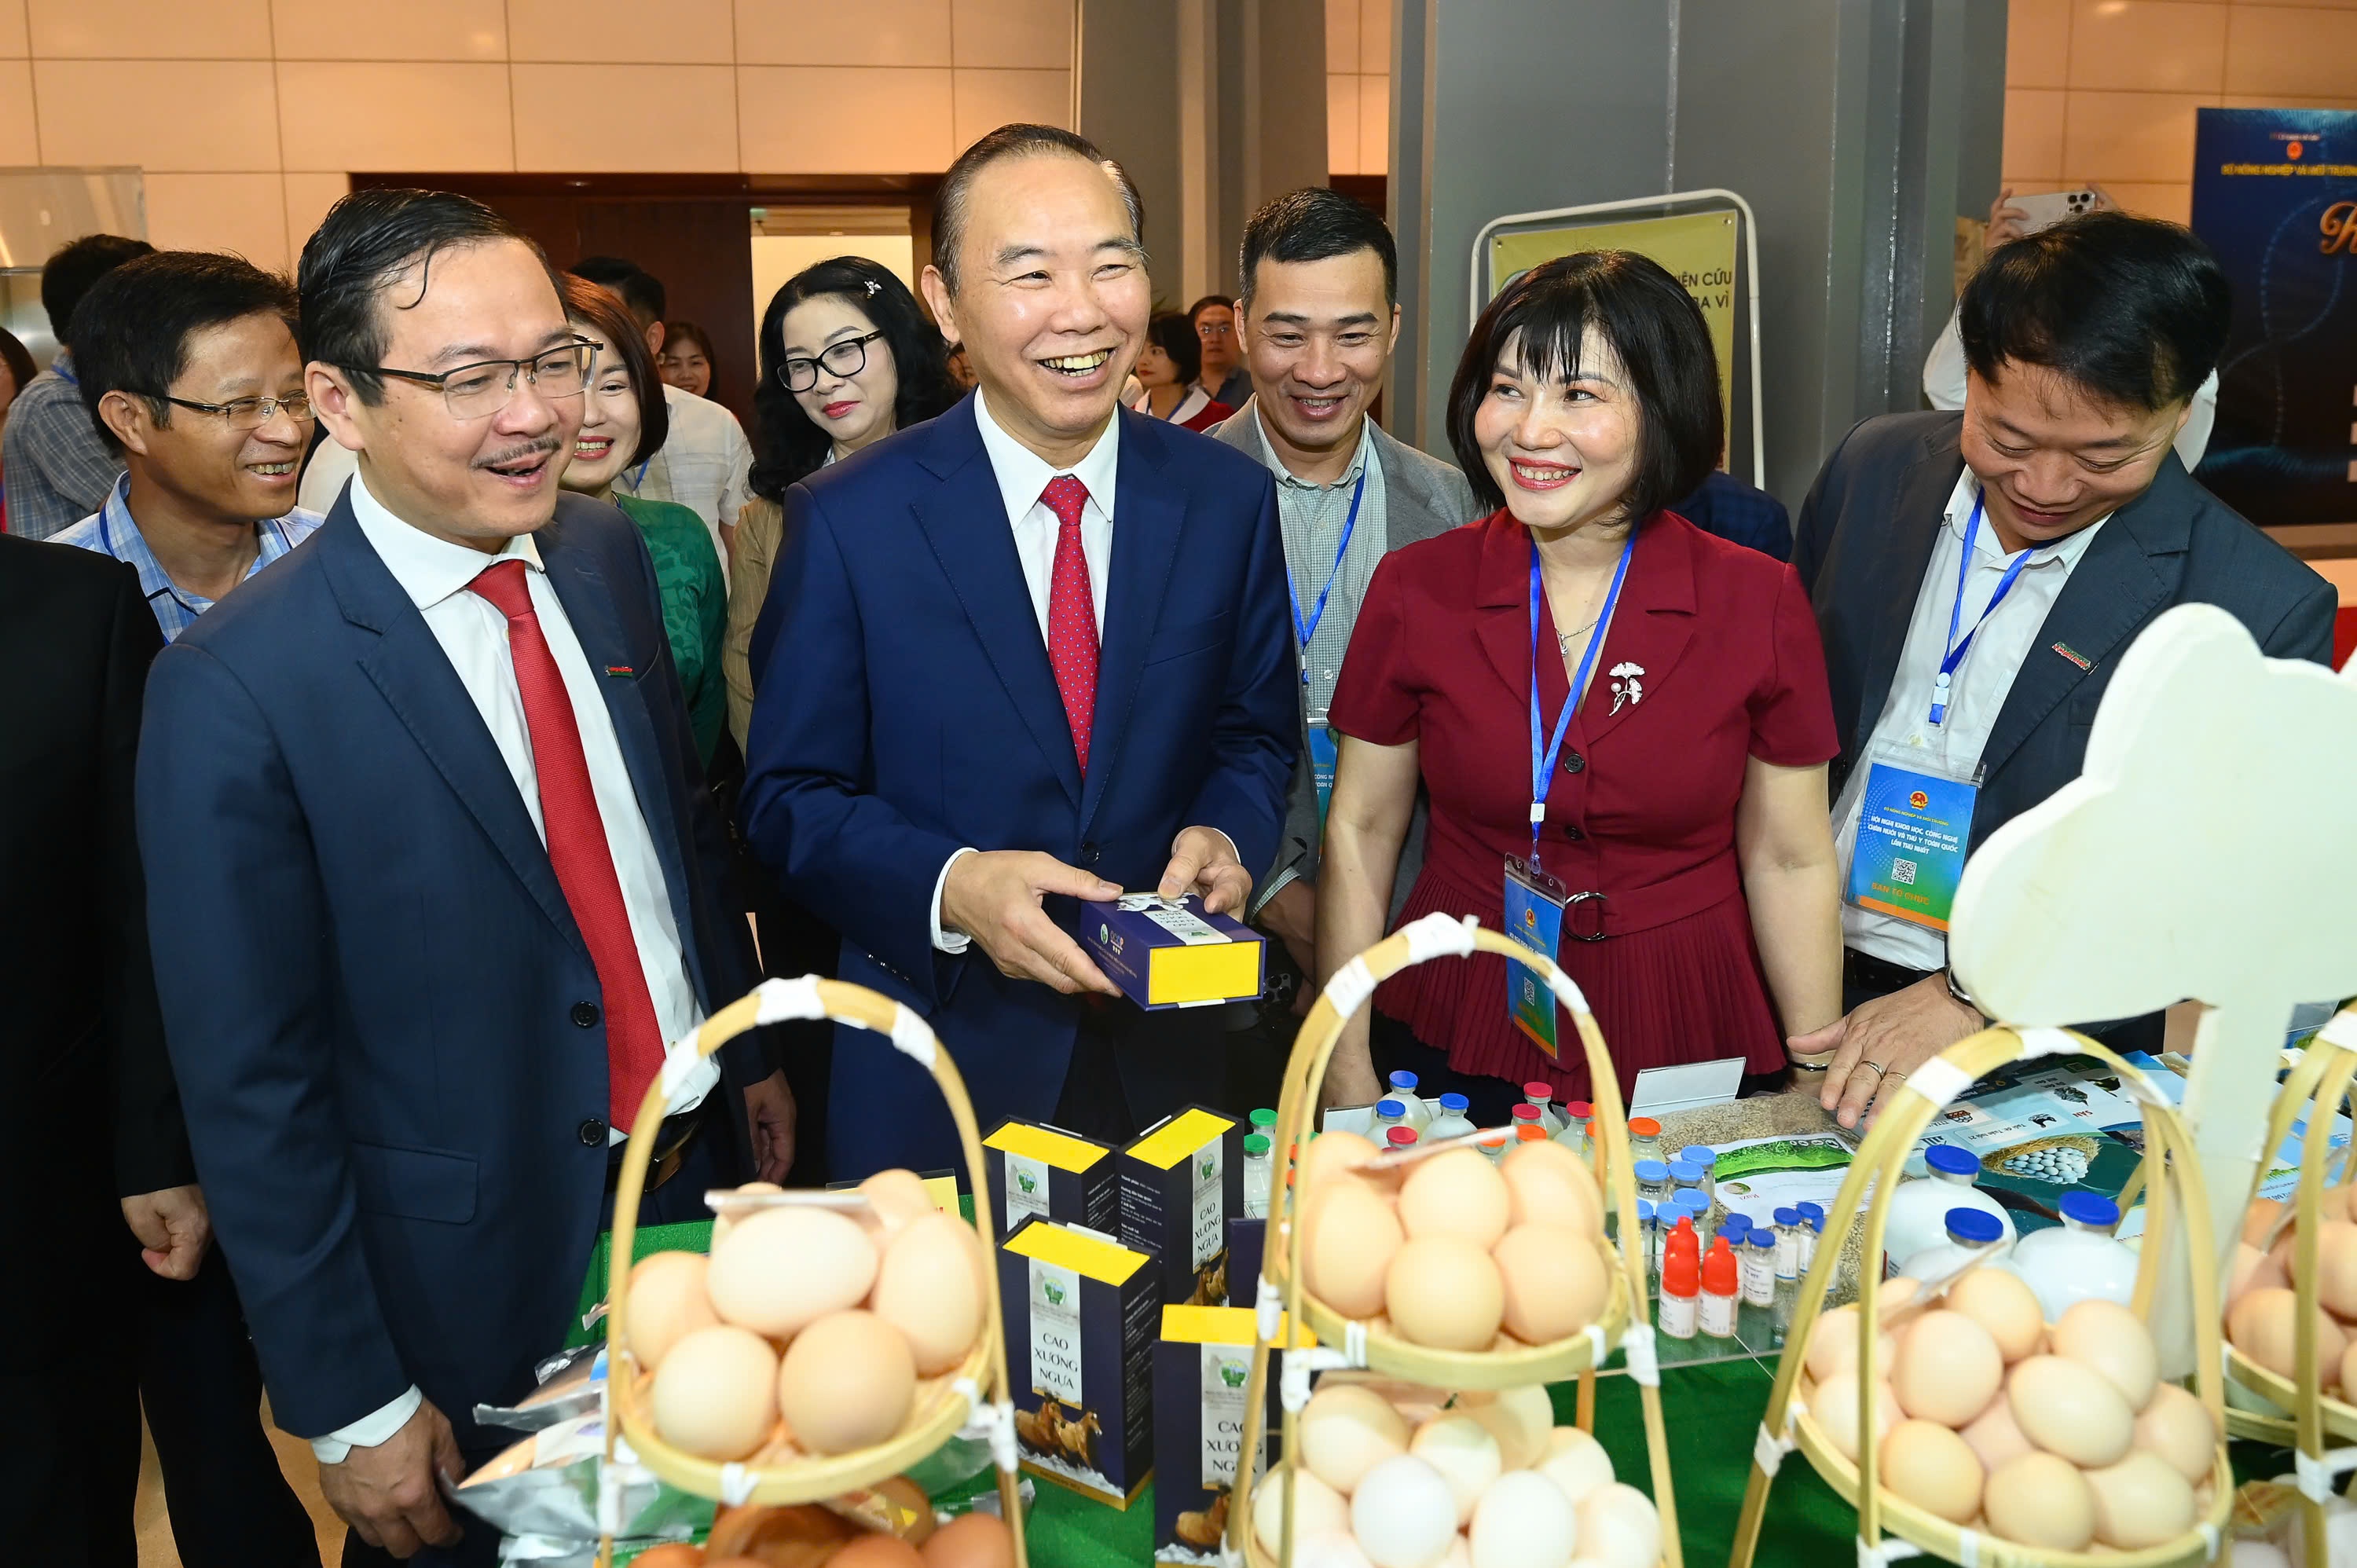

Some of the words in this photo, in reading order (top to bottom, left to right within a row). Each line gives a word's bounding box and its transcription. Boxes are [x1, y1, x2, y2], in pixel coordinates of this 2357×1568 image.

[1702, 267, 1732, 287] CỨU
[1715, 290, 1729, 308] VÌ
[1200, 1202, 1215, 1220] CAO
[1043, 1332, 1069, 1350] CAO
